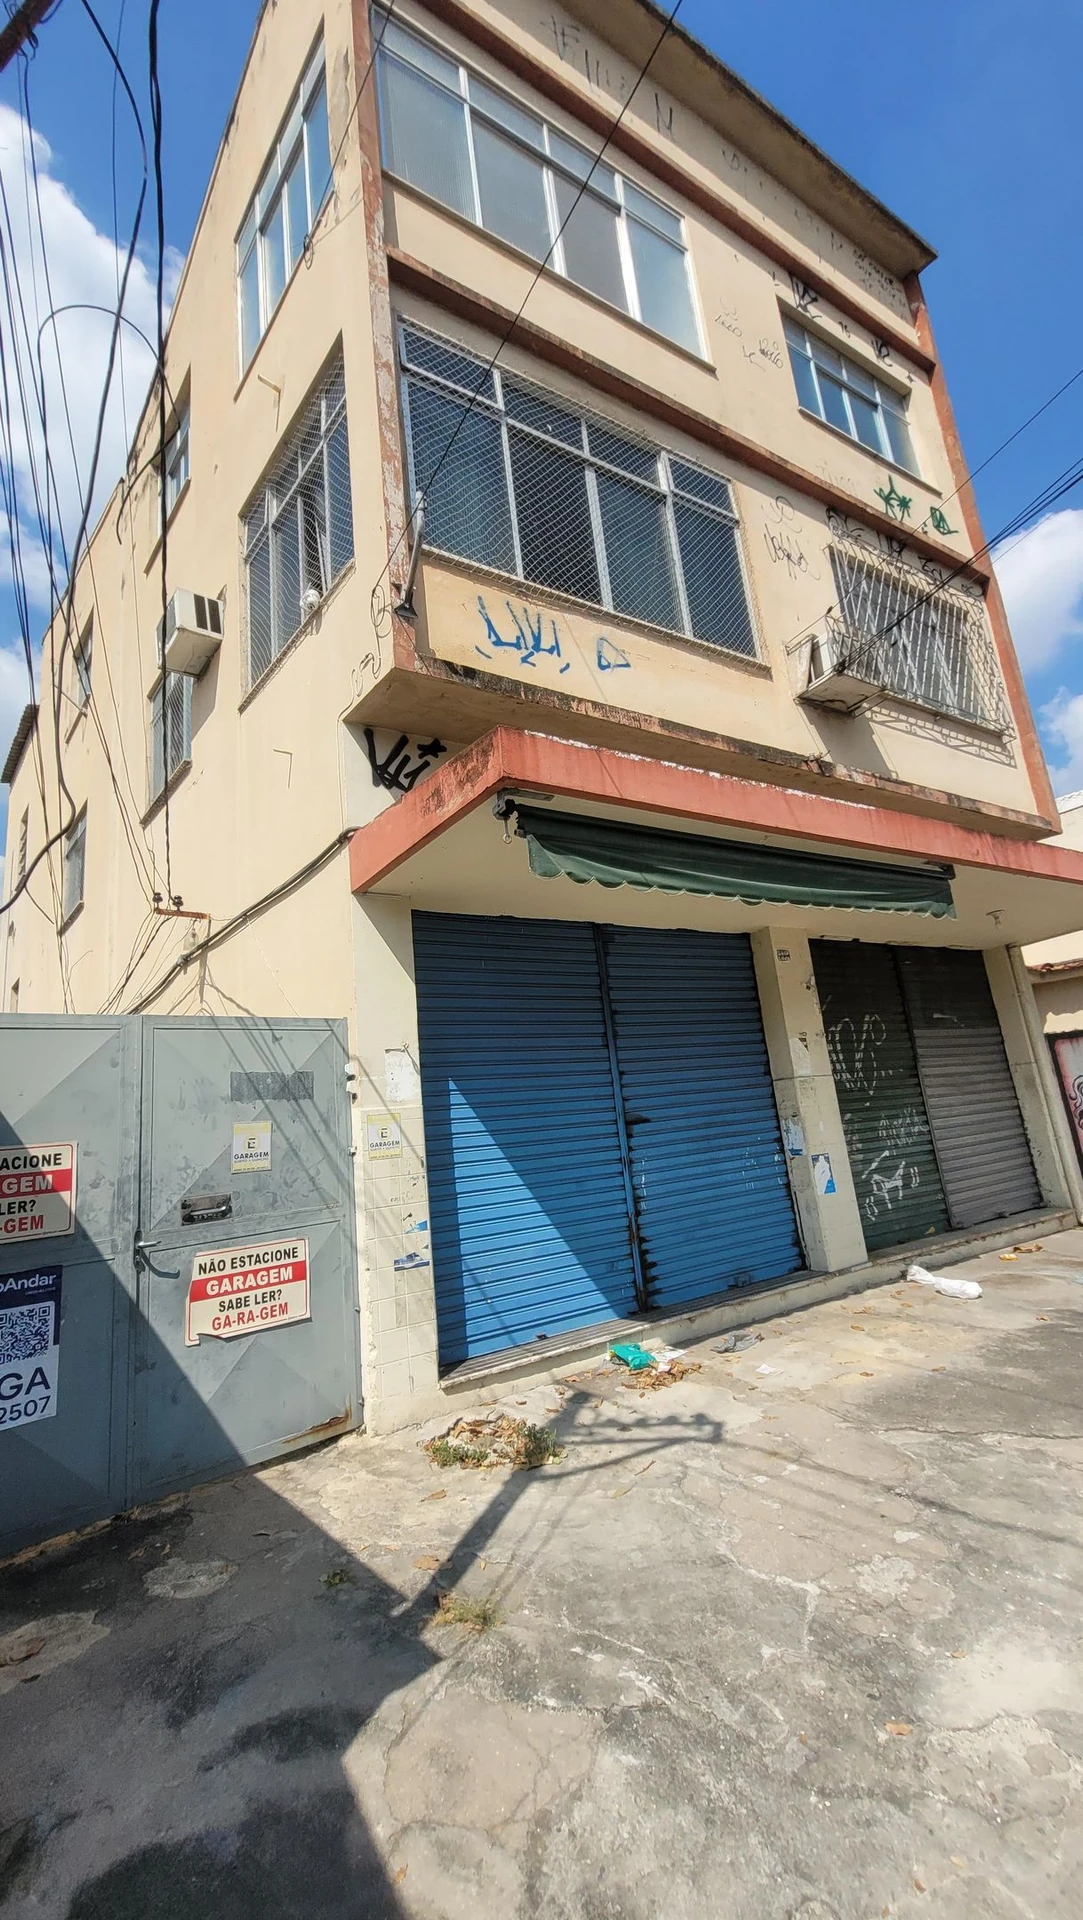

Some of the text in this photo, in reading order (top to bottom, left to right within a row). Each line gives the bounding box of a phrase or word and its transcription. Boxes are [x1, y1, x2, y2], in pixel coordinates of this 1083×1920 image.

[234, 1151, 269, 1160] GARAGEM
[370, 1140, 400, 1149] GARAGEM
[0, 1153, 62, 1171] ACIONE
[198, 1247, 299, 1275] NÃO ESTACIONE
[206, 1266, 293, 1295] GARAGEM
[219, 1289, 282, 1312] SABE LER?
[212, 1302, 289, 1331] GA-RA-GEM
[0, 1366, 51, 1401] GA
[0, 1395, 51, 1424] 2507
